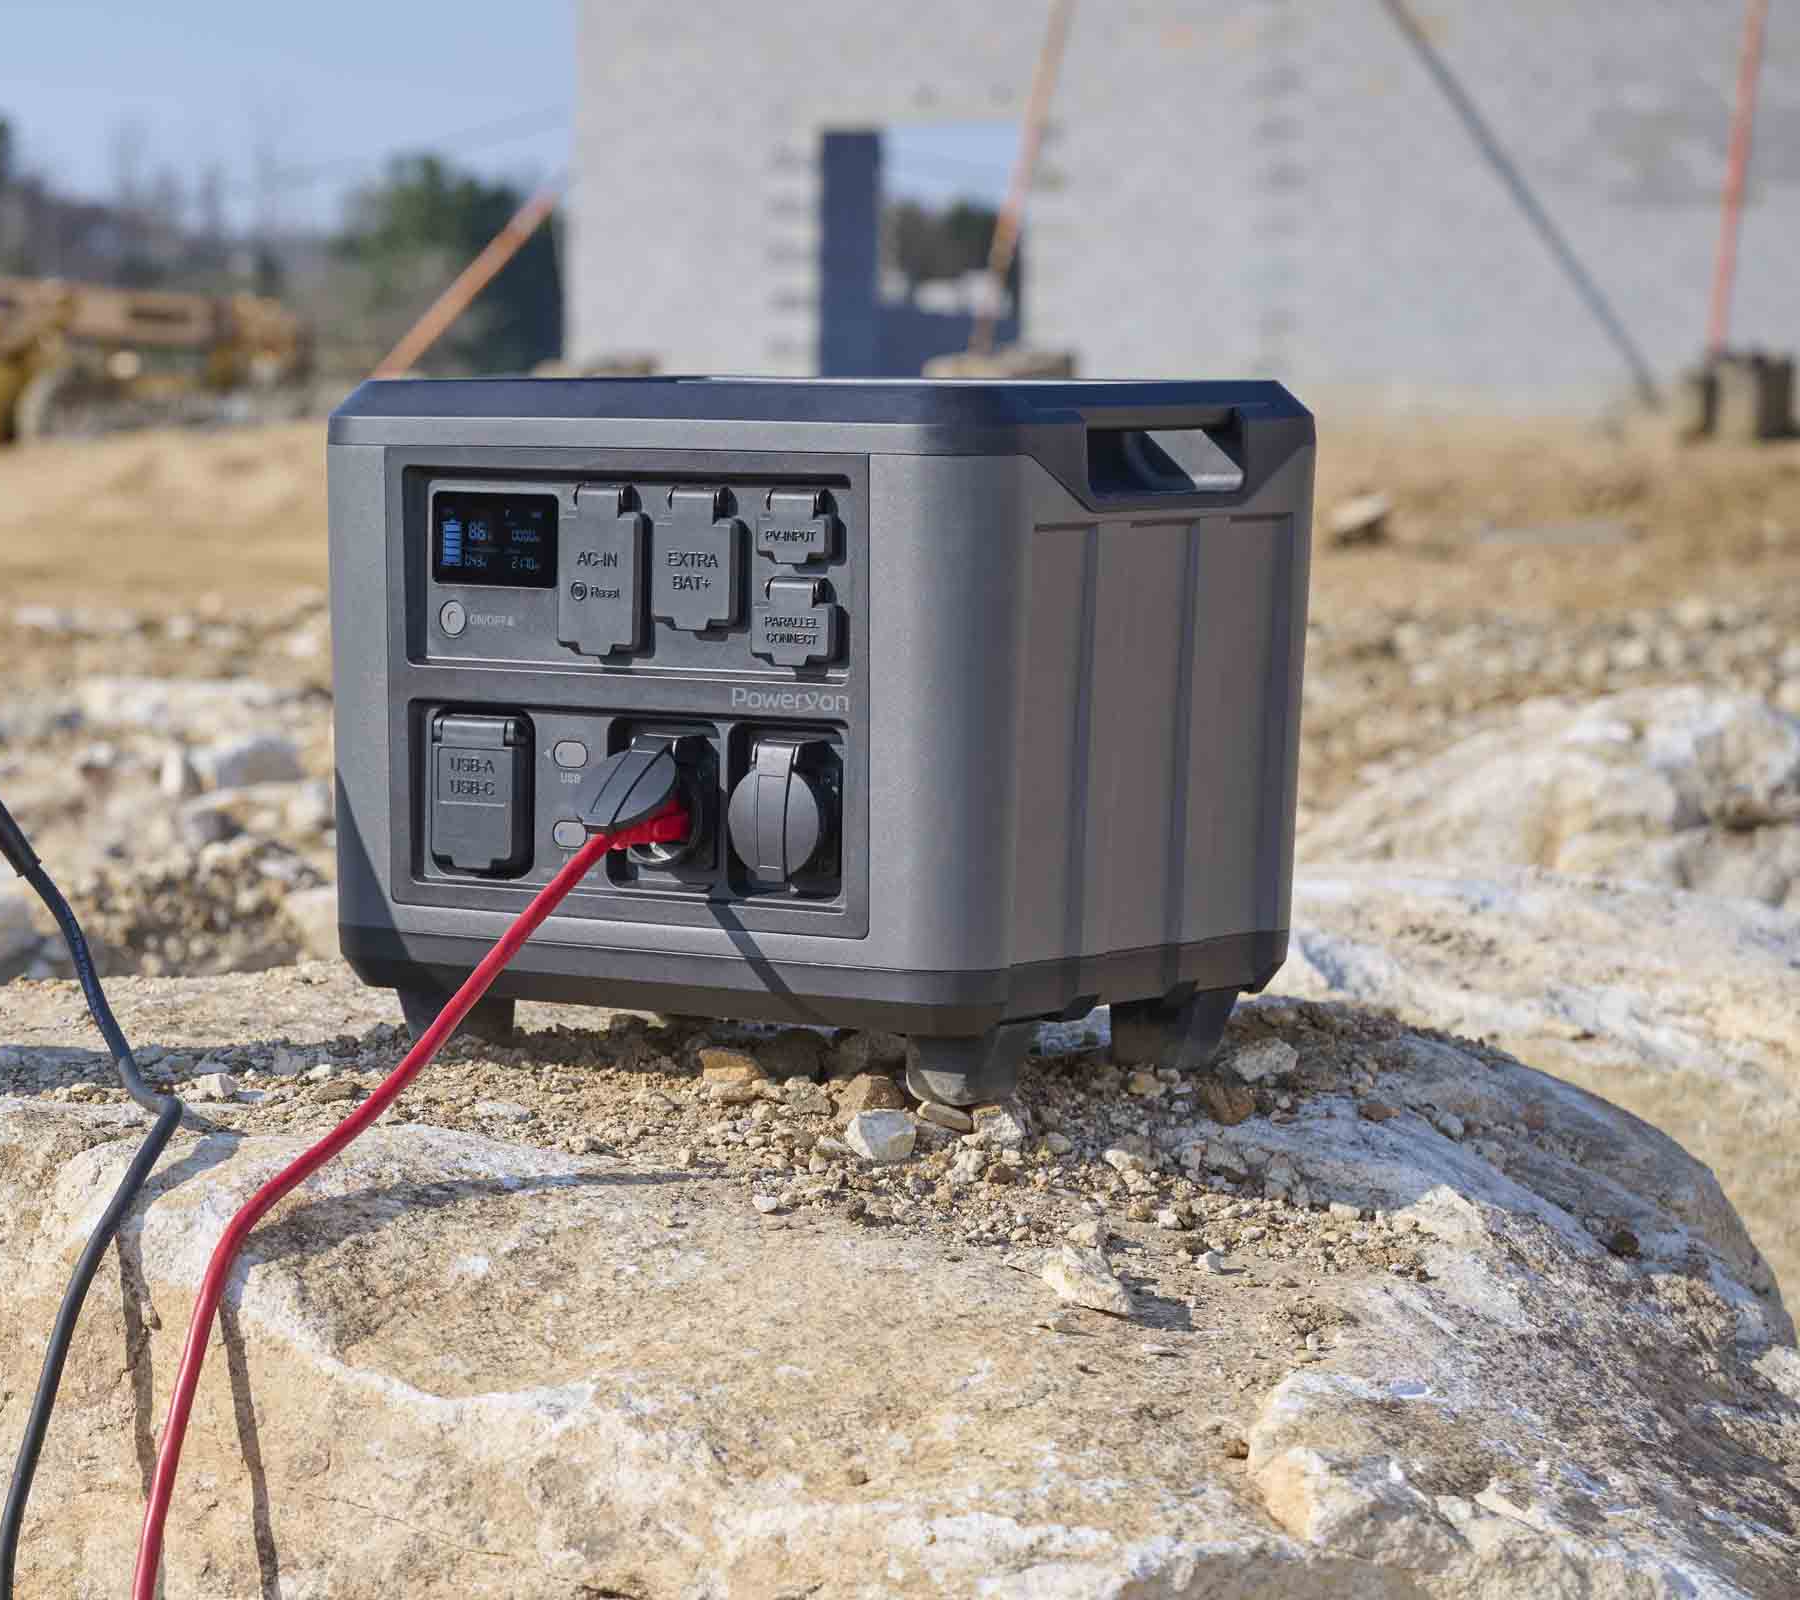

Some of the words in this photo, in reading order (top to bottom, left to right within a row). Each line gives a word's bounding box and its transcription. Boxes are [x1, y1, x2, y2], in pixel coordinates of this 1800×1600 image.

[765, 529, 817, 543] PV-INPUT
[576, 551, 618, 568] AC-IN
[667, 551, 718, 569] EXTRA
[672, 575, 712, 591] BAT+
[590, 586, 620, 599] Reset
[764, 616, 820, 629] PARALLEL
[766, 632, 819, 645] CONNECT
[449, 757, 496, 774] USB-A
[560, 771, 582, 785] USB
[449, 779, 496, 796] USB-C
